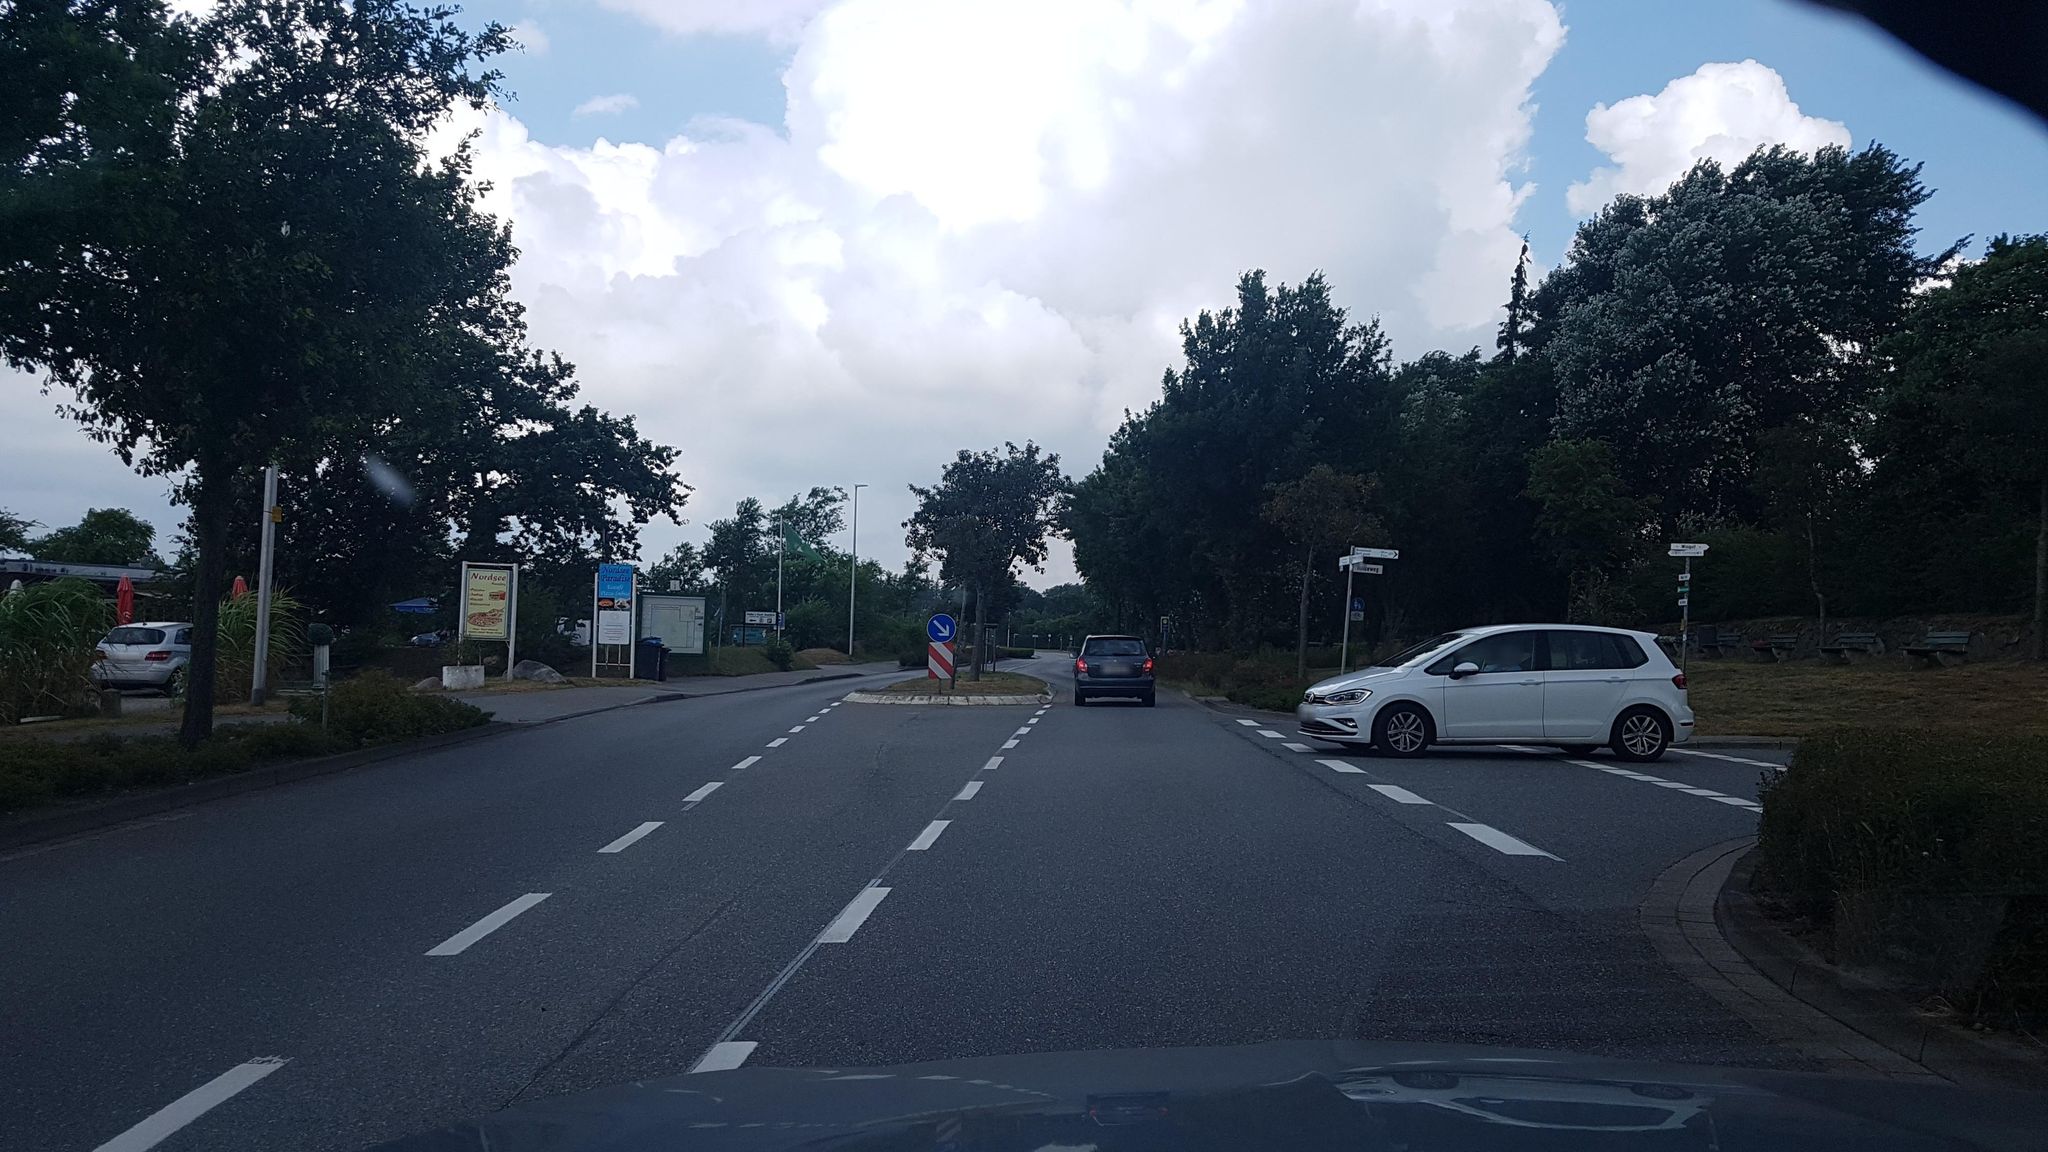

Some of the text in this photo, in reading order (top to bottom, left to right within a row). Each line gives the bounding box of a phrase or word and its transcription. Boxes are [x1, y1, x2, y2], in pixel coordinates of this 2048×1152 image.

[602, 567, 631, 575] Nordsee
[471, 572, 506, 582] Nordsee
[602, 574, 632, 583] Paradise
